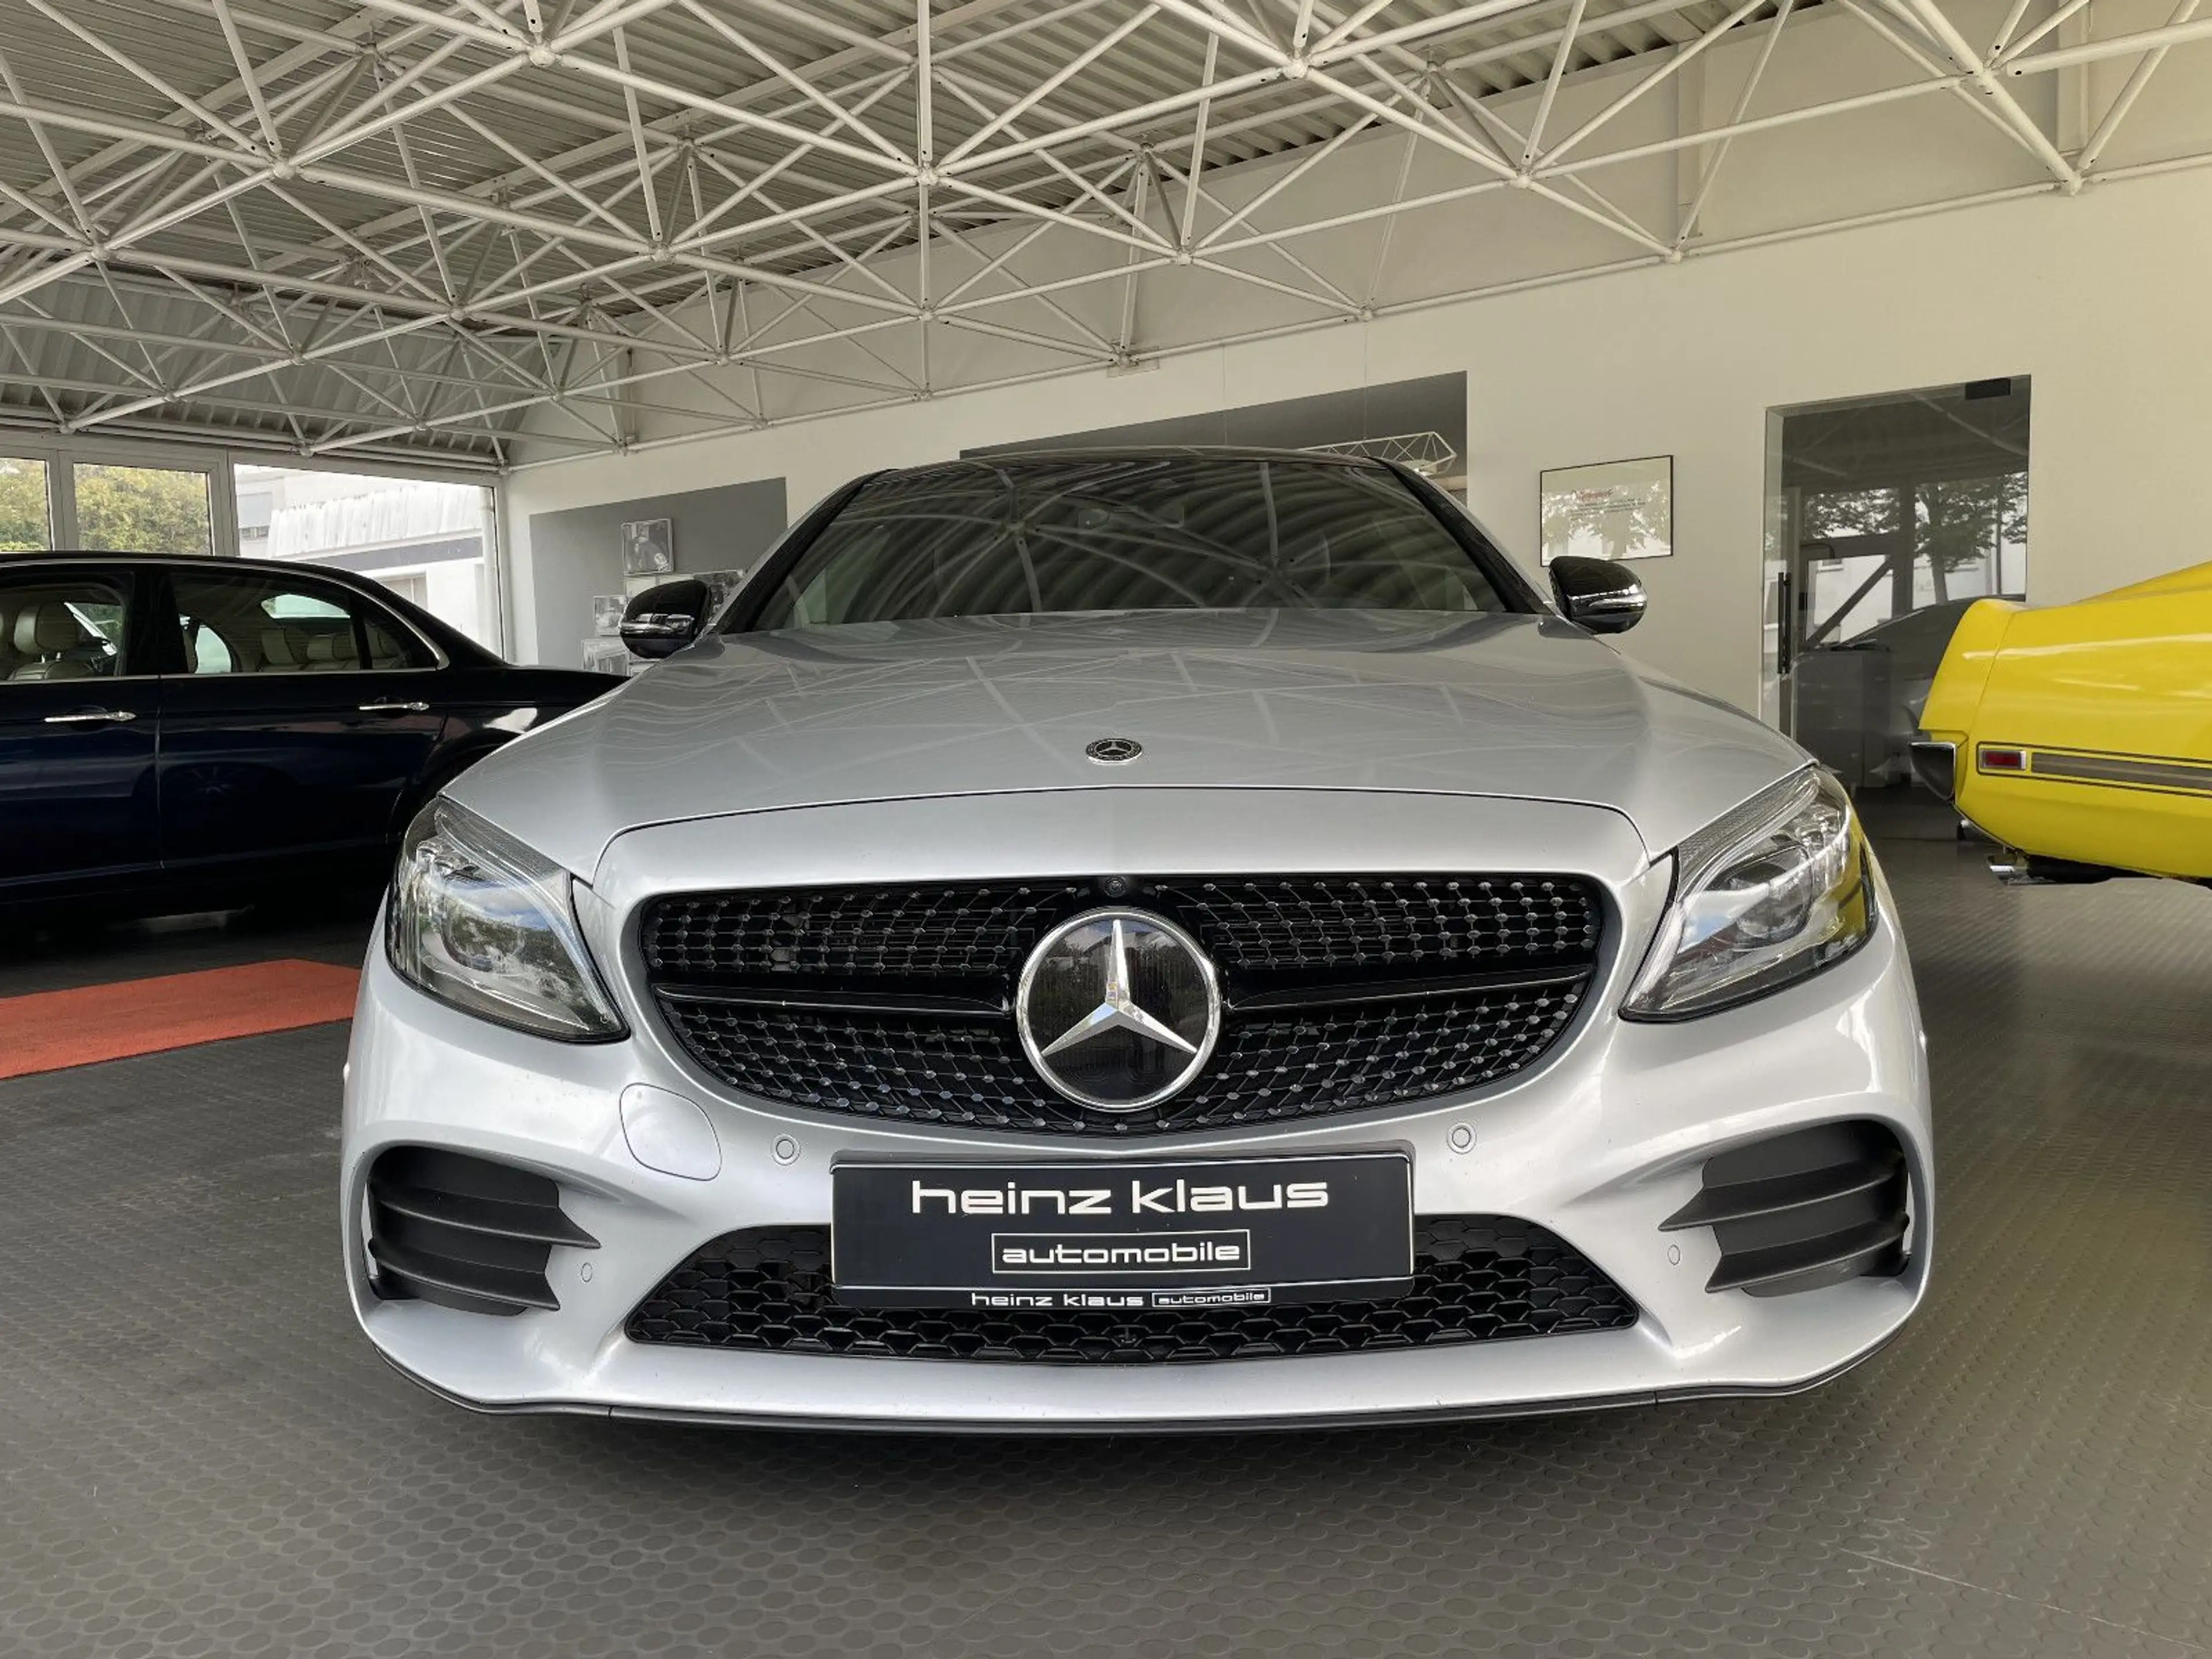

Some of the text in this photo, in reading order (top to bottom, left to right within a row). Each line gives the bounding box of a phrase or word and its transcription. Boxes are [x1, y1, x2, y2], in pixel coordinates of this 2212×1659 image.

[912, 1179, 1329, 1214] heinz klaus
[1002, 1241, 1240, 1264] automobile
[971, 1292, 1265, 1306] heinz klaus automobile
